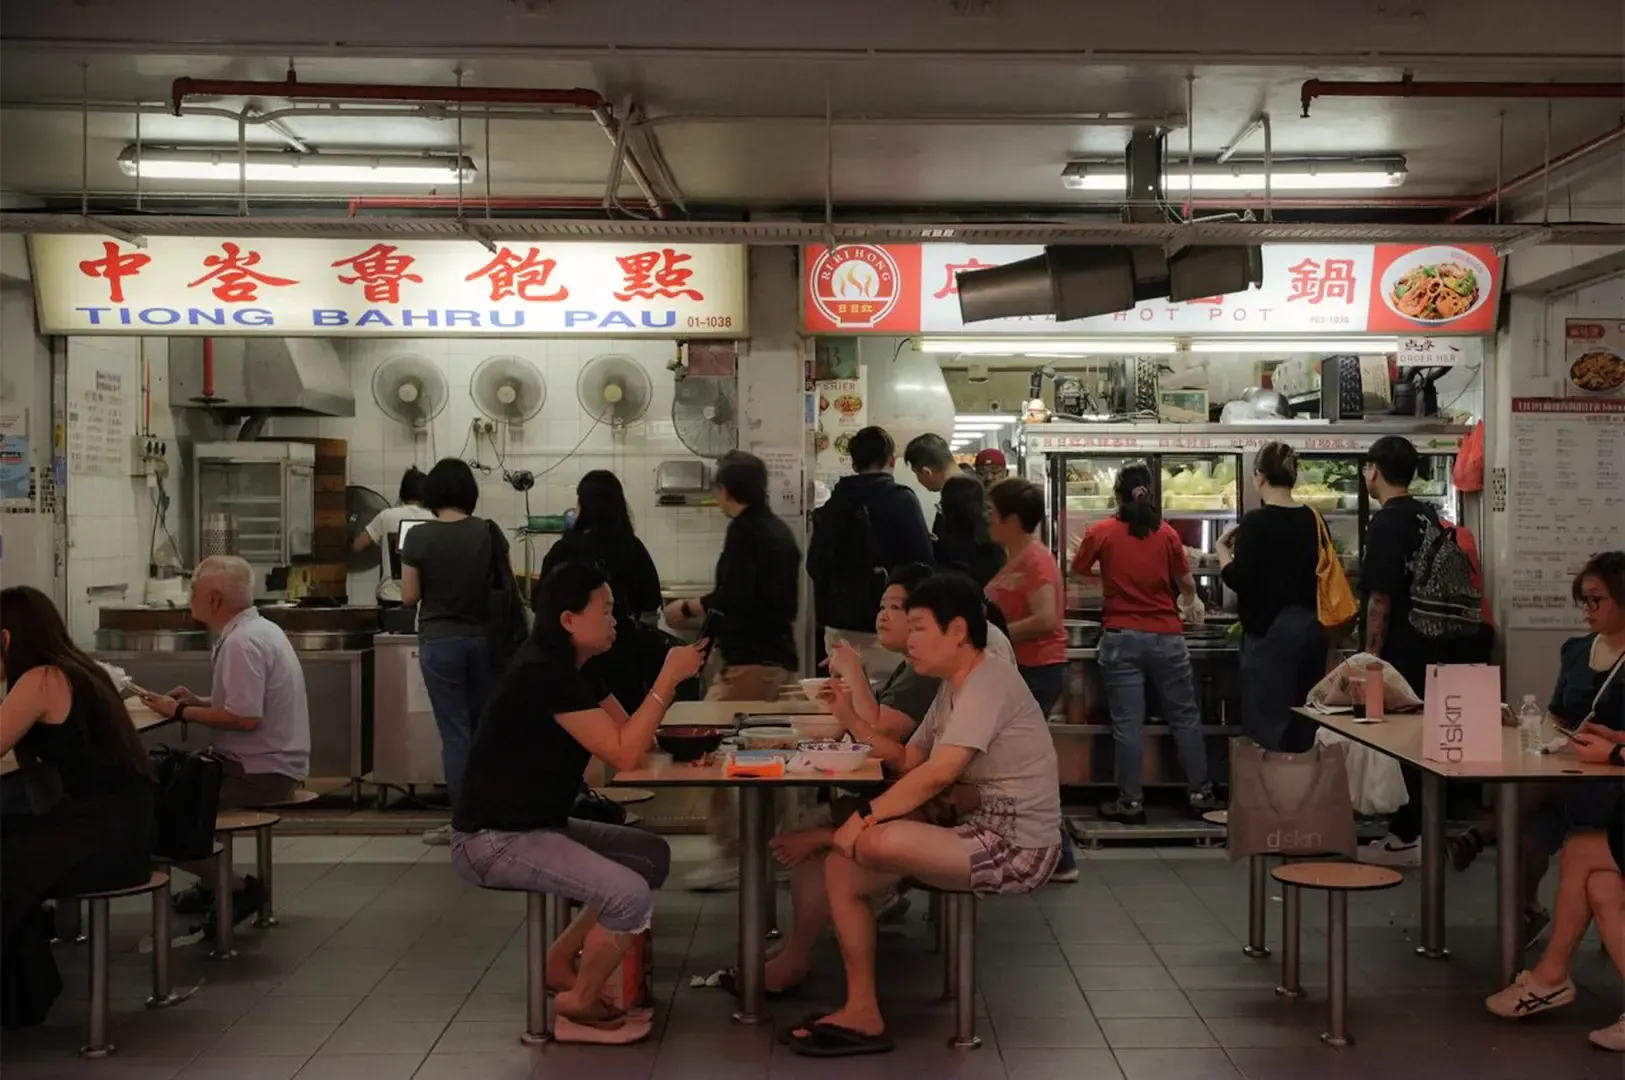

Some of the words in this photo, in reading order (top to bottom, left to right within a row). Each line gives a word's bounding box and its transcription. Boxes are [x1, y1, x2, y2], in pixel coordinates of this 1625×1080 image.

[855, 248, 892, 281] HONG
[76, 307, 274, 326] TIONG
[312, 309, 526, 327] BAHRU
[564, 310, 677, 328] PAU
[687, 316, 732, 328] 01-1038
[1209, 308, 1272, 321] POT
